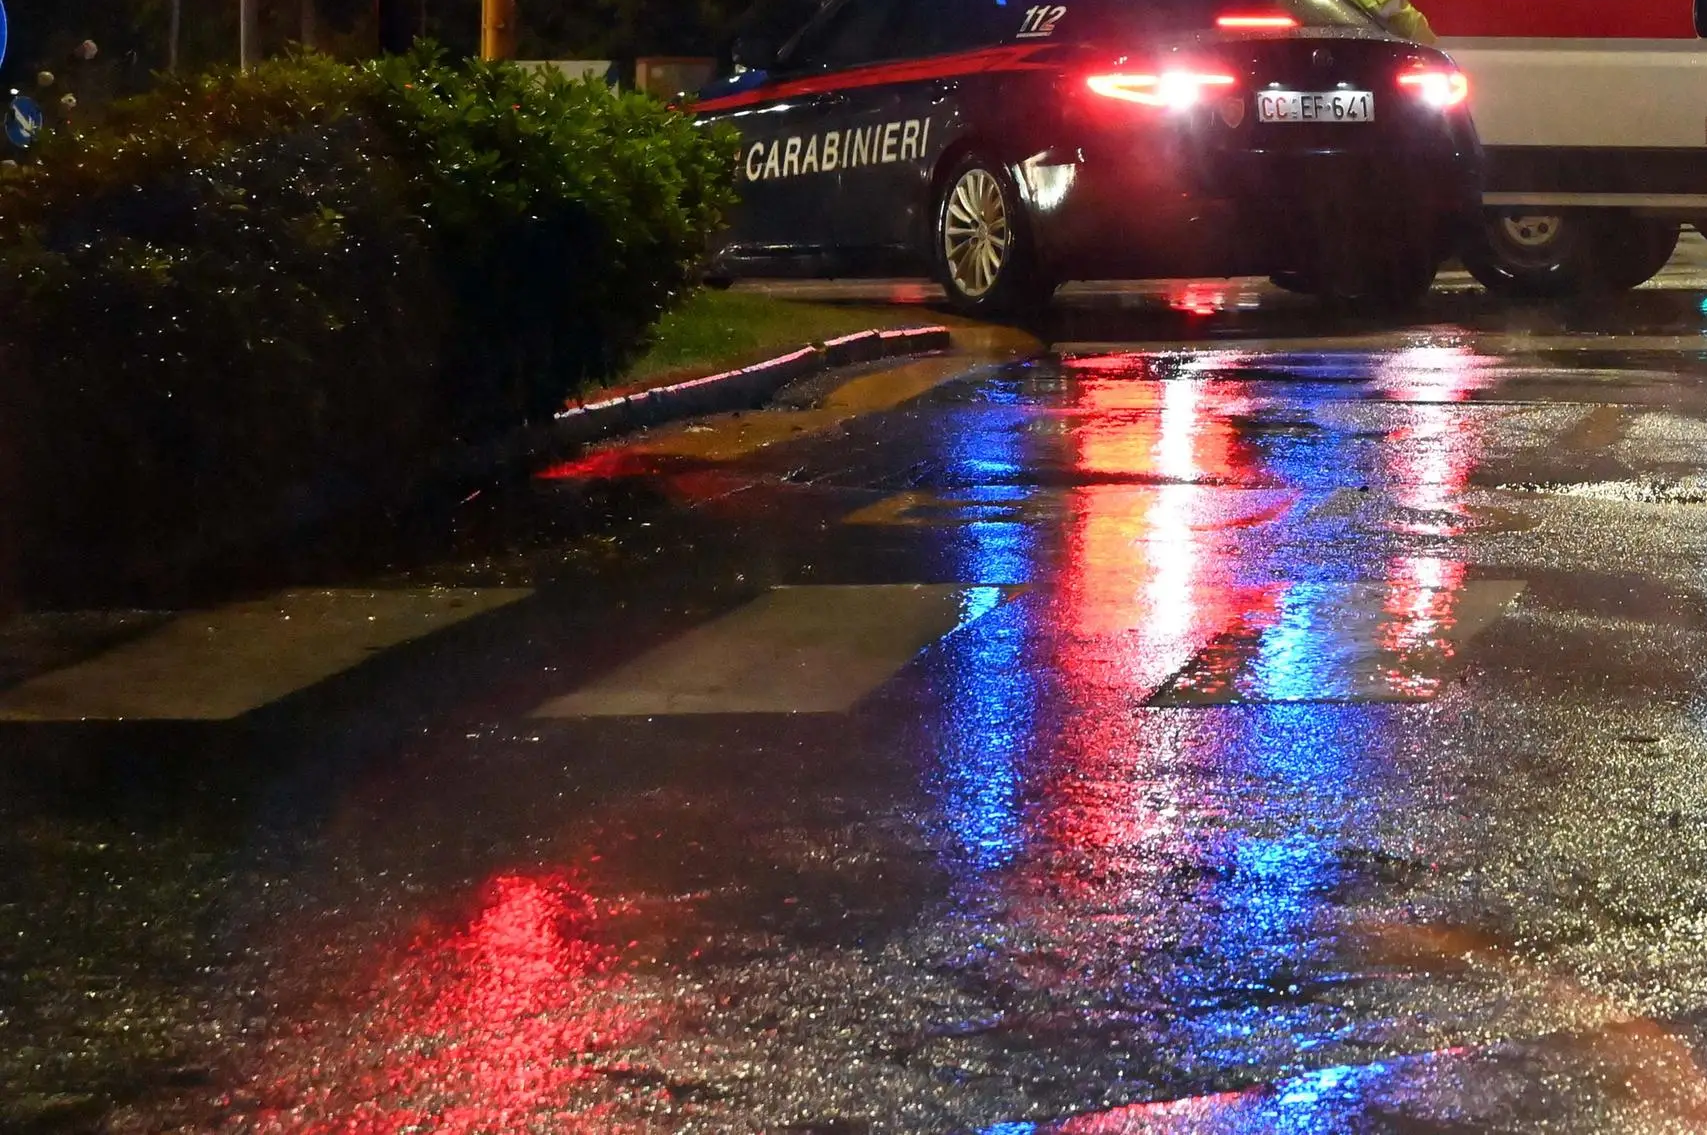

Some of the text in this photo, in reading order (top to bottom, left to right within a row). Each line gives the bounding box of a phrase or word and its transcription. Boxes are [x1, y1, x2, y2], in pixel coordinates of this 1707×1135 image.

[1018, 5, 1068, 33] 112
[1262, 96, 1369, 120] CC EF 641
[745, 116, 931, 182] CARABINIERI
